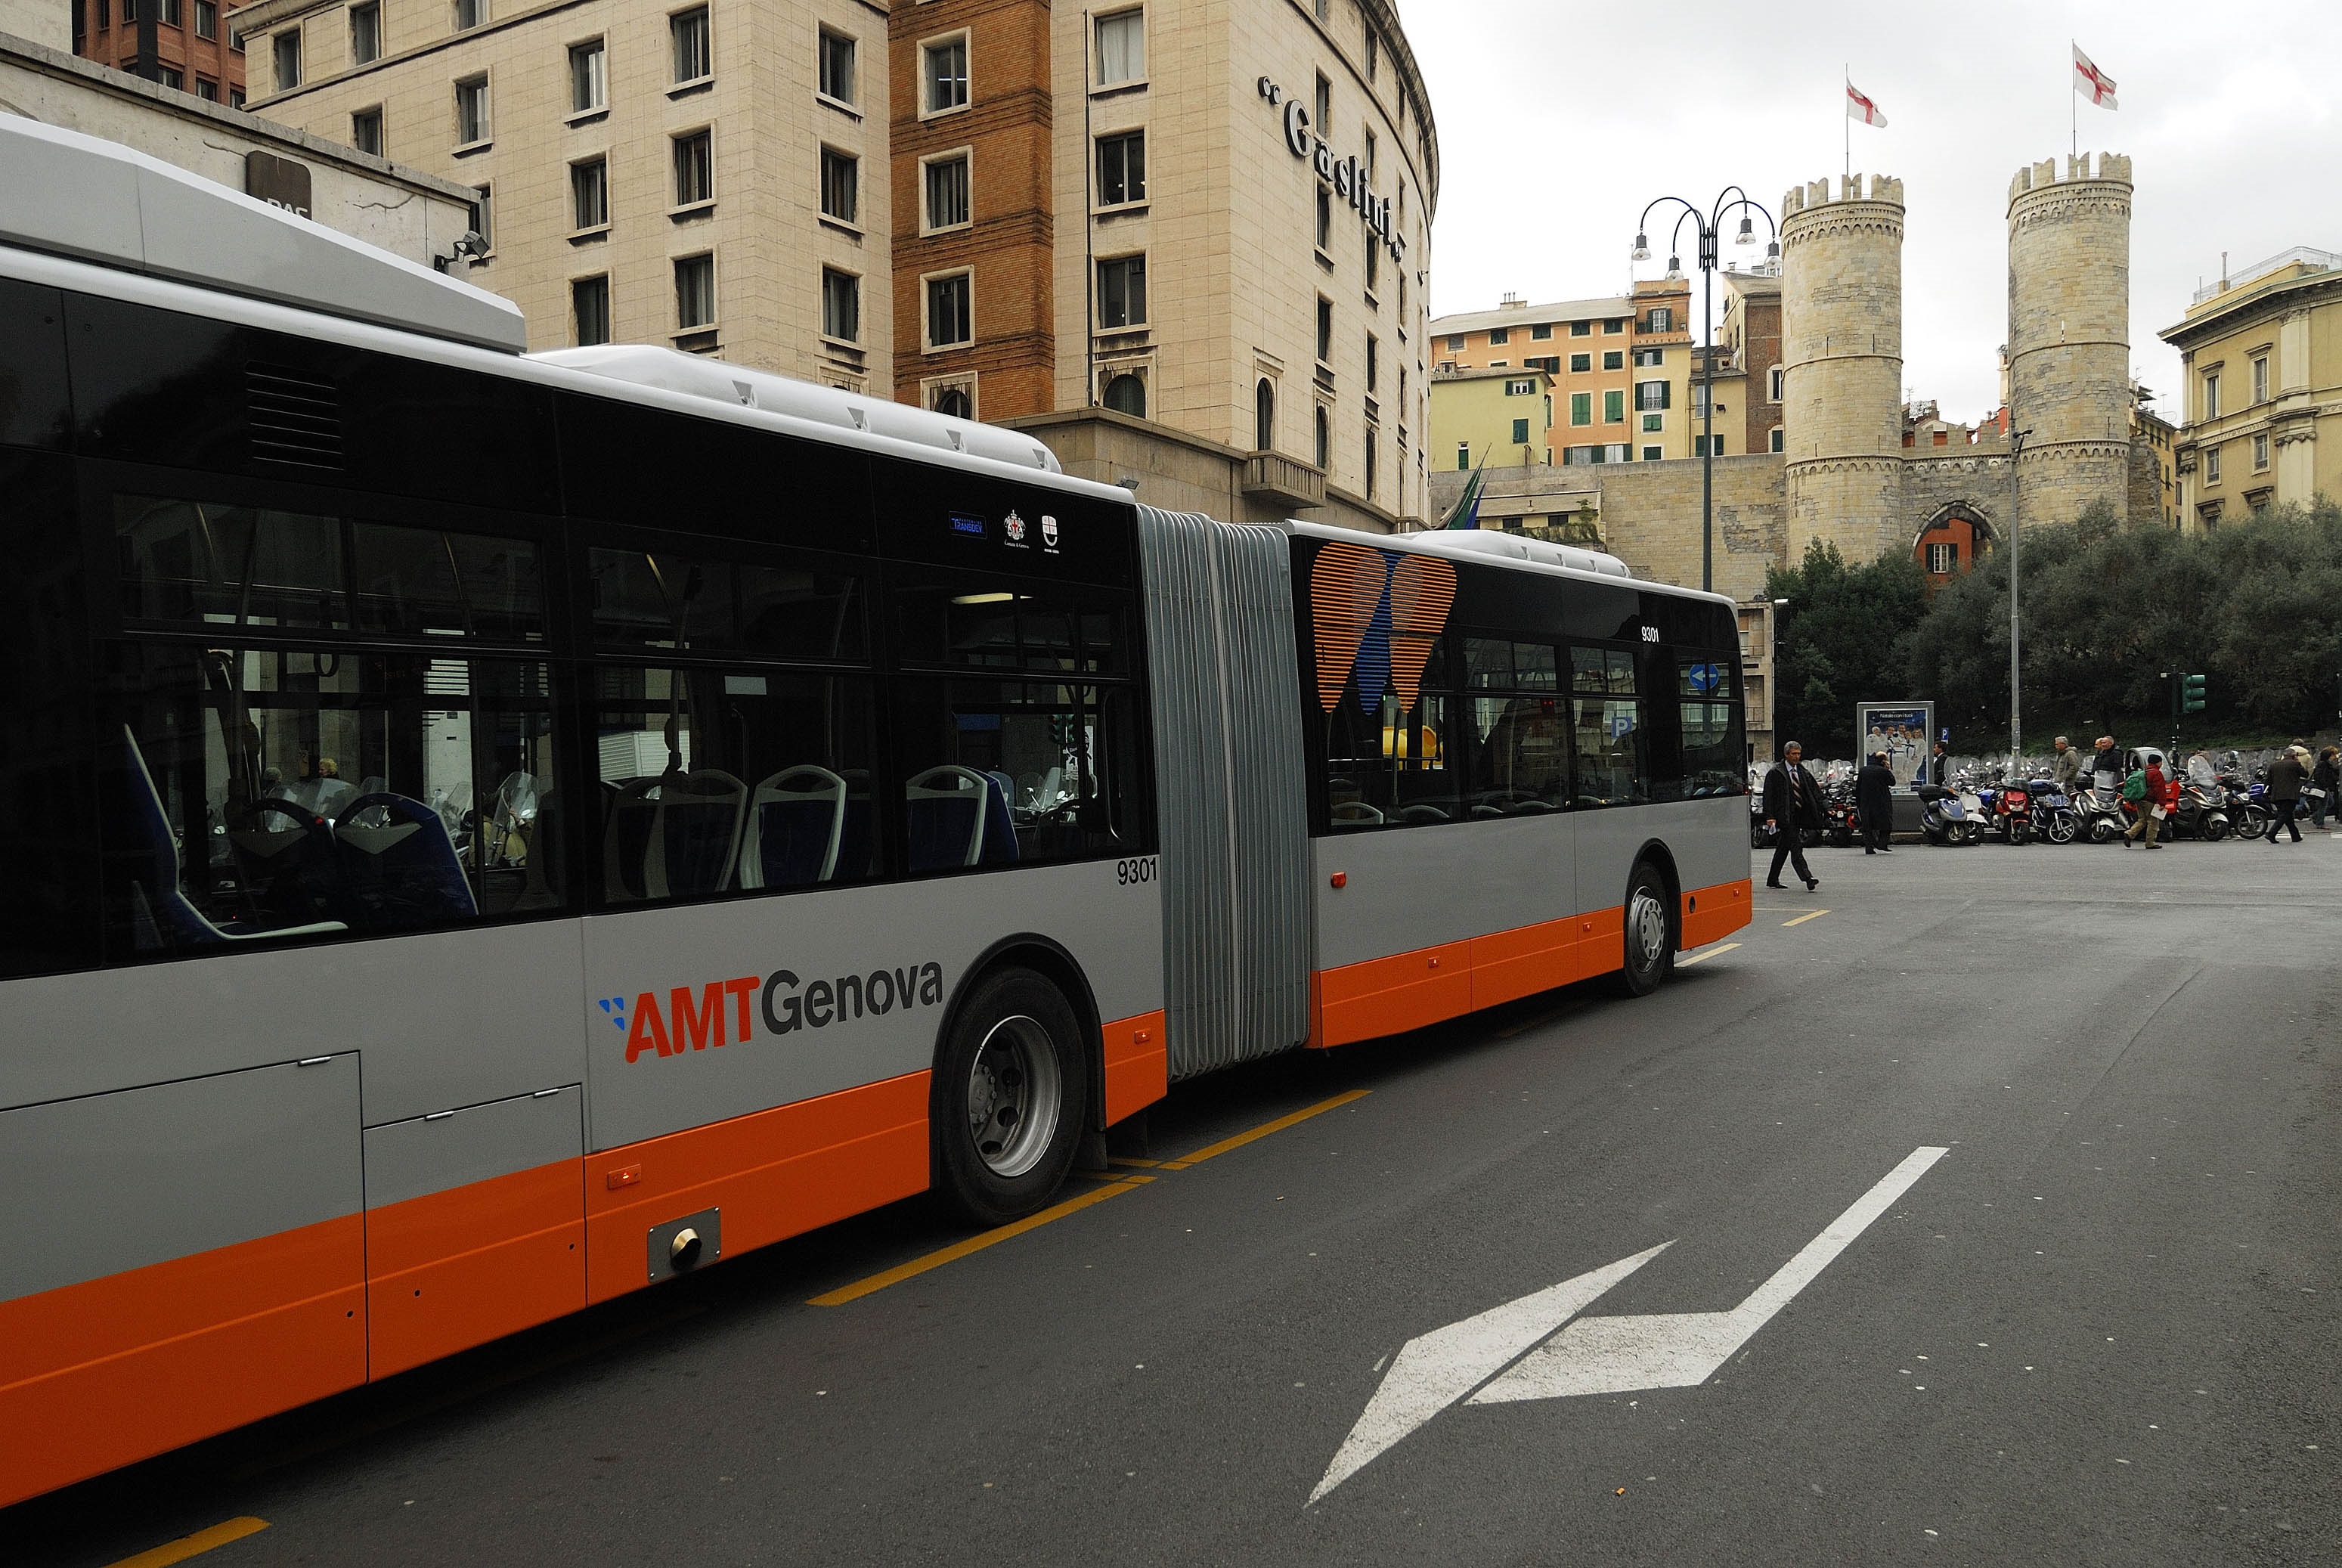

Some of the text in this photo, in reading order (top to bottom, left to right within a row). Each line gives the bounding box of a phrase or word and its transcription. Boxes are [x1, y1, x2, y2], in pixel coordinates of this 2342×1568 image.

[1641, 625, 1659, 643] 9301
[1616, 718, 1628, 736] P
[1942, 729, 1947, 739] P
[1117, 857, 1157, 886] 9301
